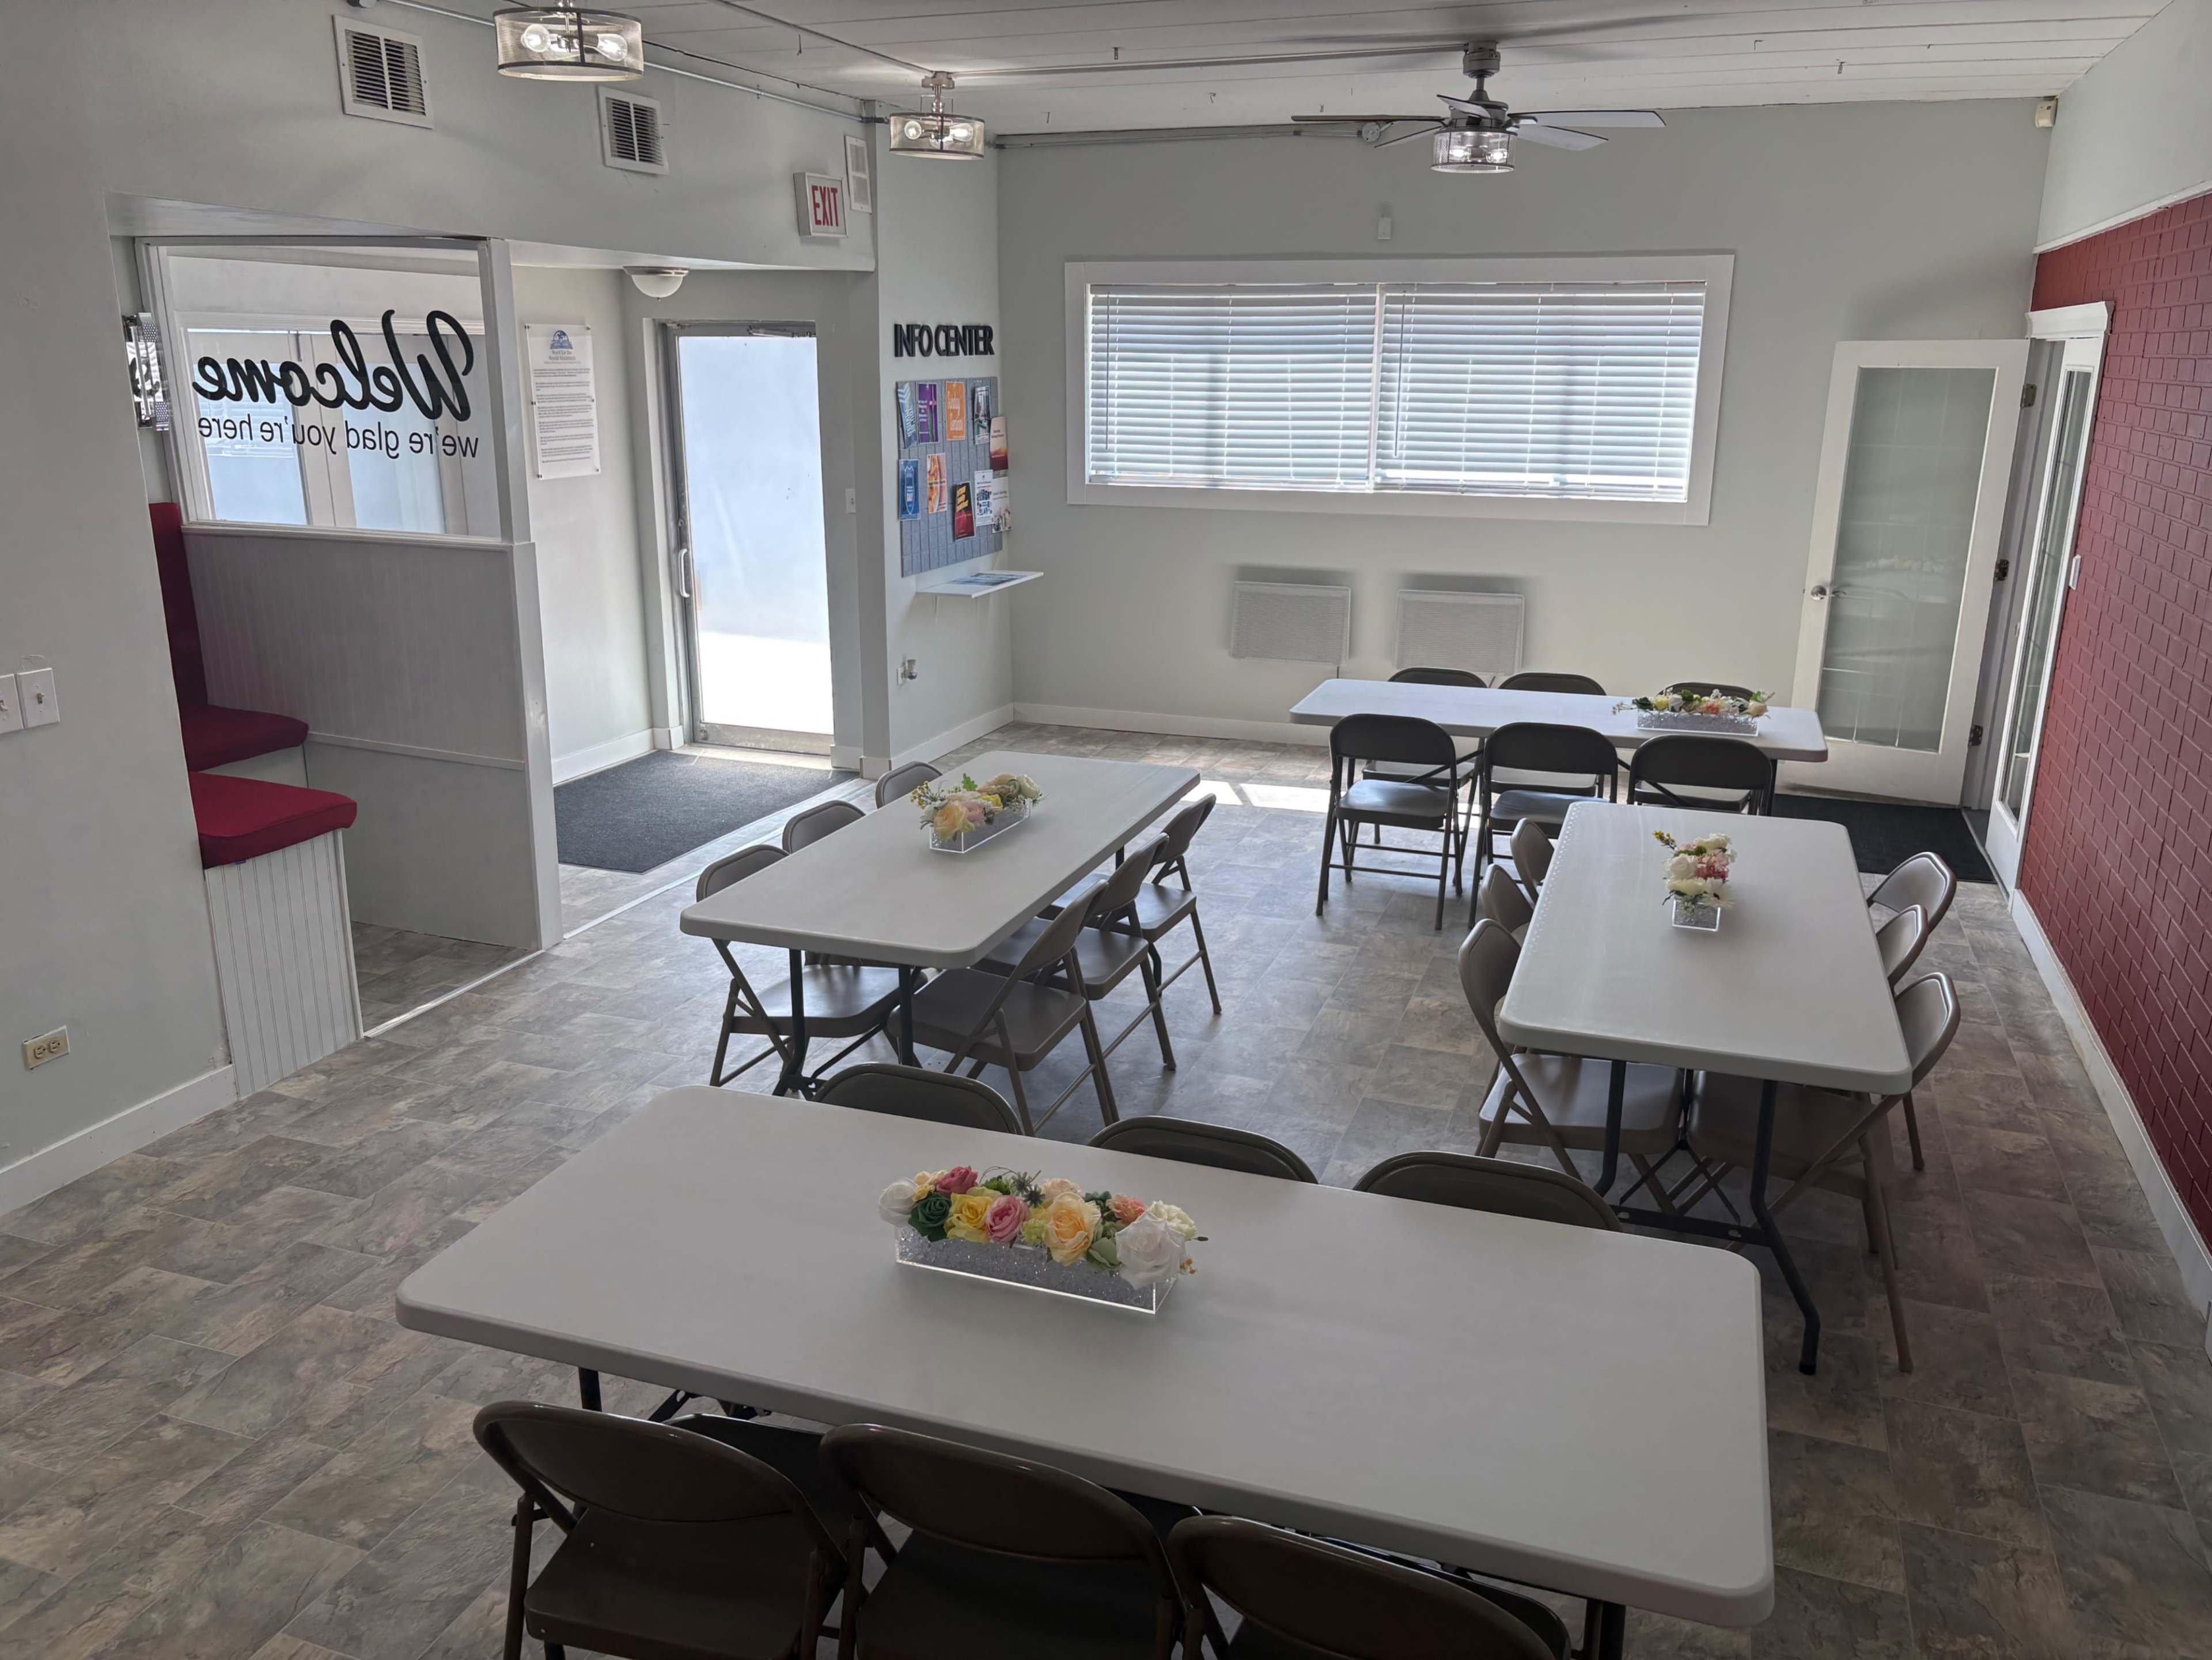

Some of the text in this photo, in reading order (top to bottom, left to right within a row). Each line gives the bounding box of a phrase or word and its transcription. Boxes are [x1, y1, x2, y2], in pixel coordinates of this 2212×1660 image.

[811, 184, 839, 227] EXIT
[894, 324, 995, 357] INFO CENTER
